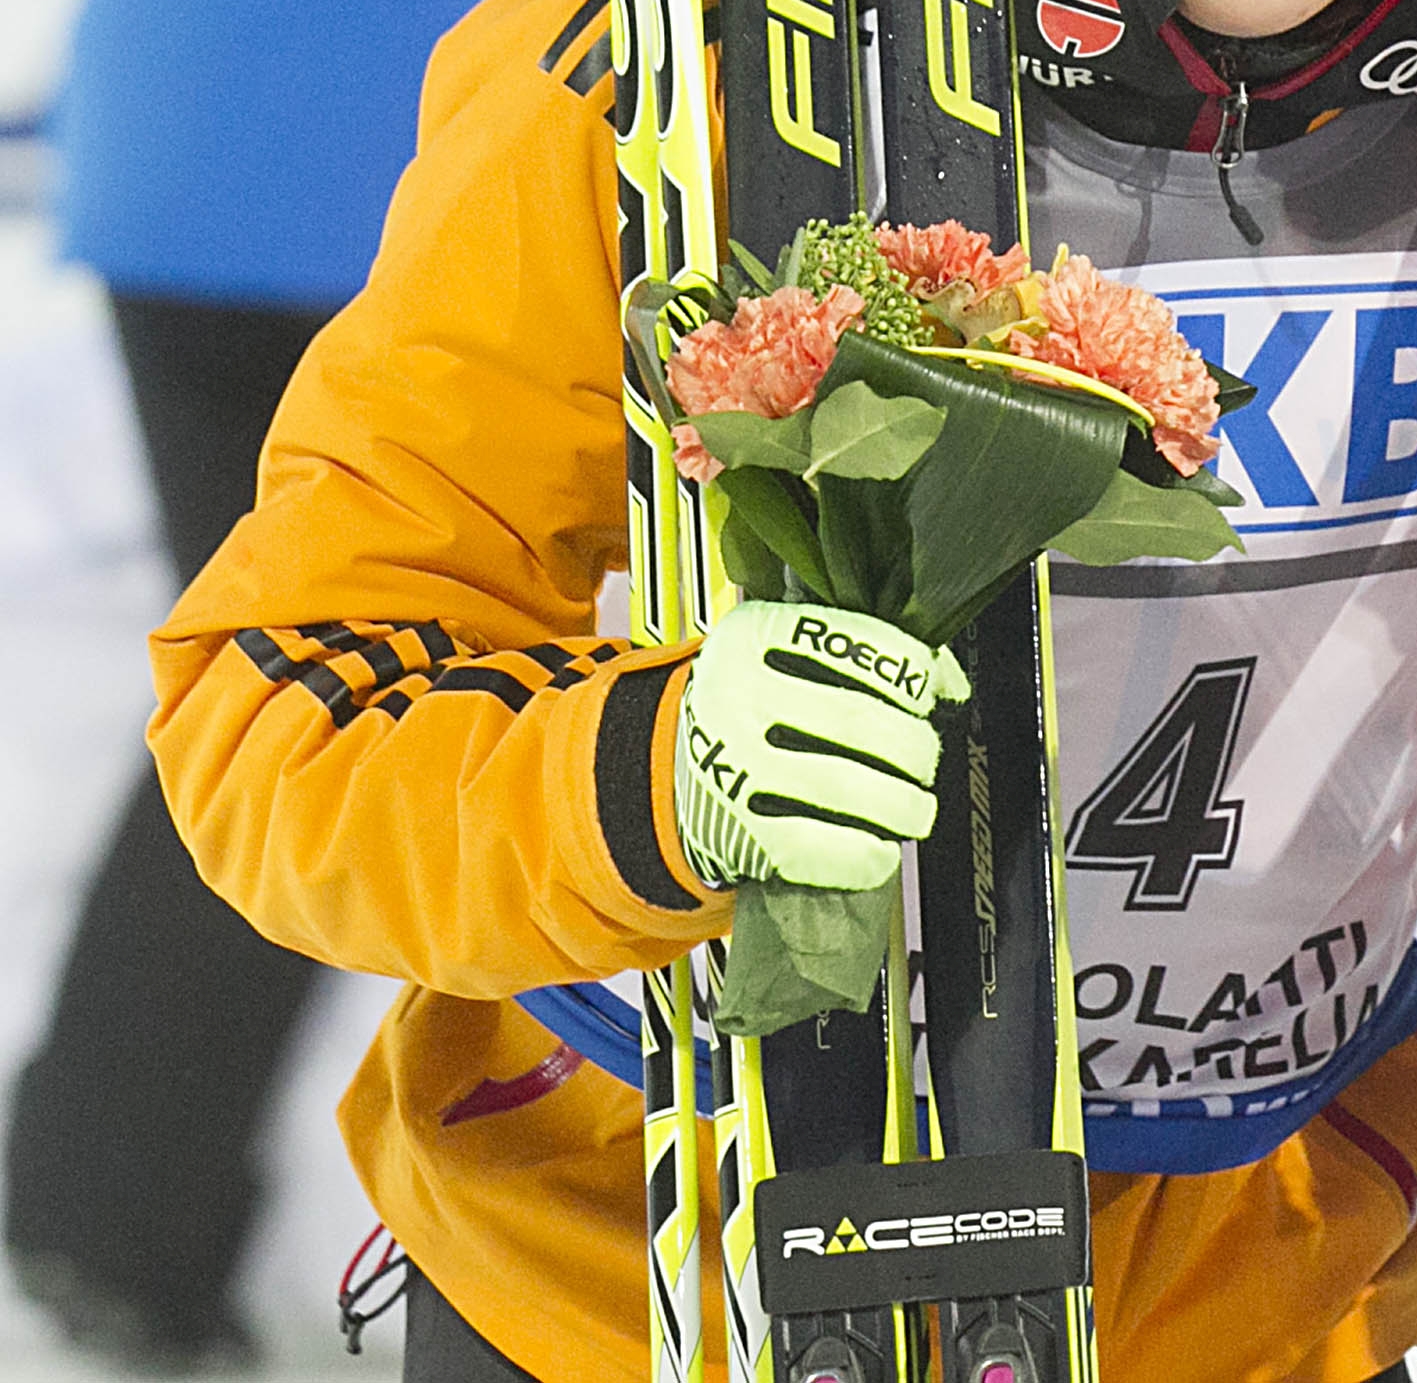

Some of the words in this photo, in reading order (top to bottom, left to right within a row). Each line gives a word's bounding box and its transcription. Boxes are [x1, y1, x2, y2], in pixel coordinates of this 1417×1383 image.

[1019, 54, 1113, 89] ÜR
[1065, 656, 1258, 912] 4
[1074, 920, 1367, 1033] OLATI
